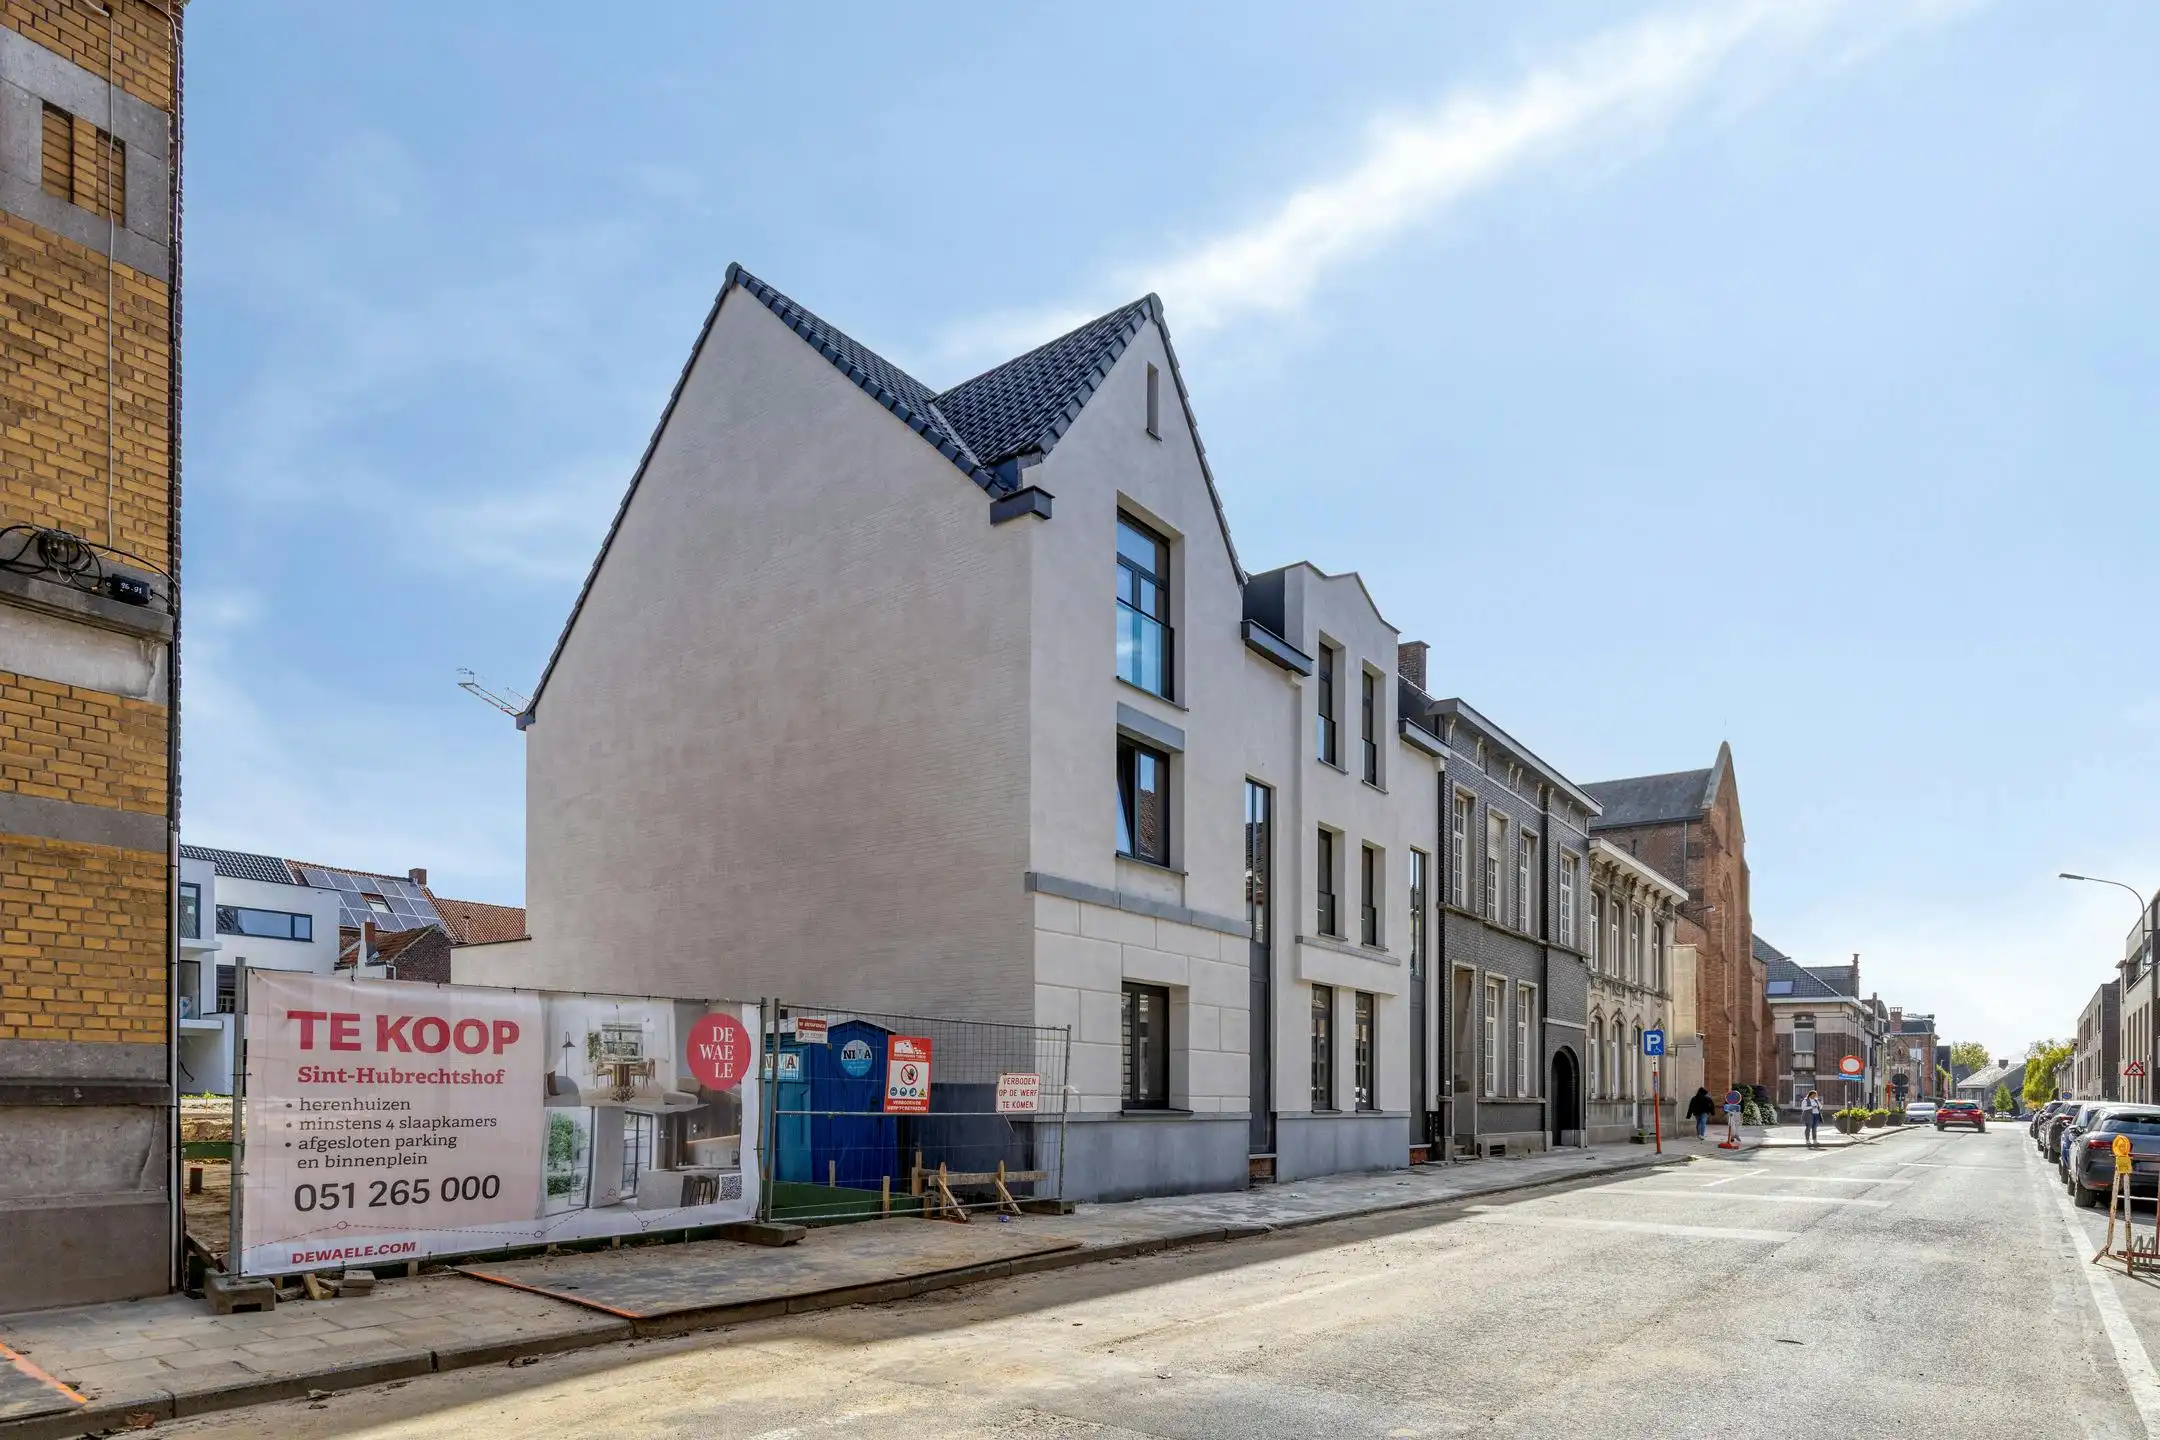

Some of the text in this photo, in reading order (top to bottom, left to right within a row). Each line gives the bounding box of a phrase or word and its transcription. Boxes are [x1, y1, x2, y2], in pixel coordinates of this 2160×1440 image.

[287, 1010, 520, 1055] TE KOOP
[712, 1026, 734, 1043] DE
[1646, 1034, 1661, 1052] P
[699, 1044, 734, 1061] WAE
[297, 1066, 506, 1085] Sint-Hubrechtshof
[714, 1062, 734, 1078] LE
[1003, 1077, 1036, 1085] VERBODEN
[1009, 1089, 1018, 1097] DE
[1020, 1089, 1038, 1097] WERF
[299, 1097, 412, 1112] herenhuizen
[1002, 1101, 1034, 1109] TE KOMEN
[299, 1115, 498, 1131] minstens 4 slaapkamers
[298, 1133, 458, 1152] afgesloten parking
[297, 1152, 428, 1169] en binnenplein
[294, 1174, 500, 1212] 051 265 000
[291, 1241, 417, 1265] DEWAELE.COM
